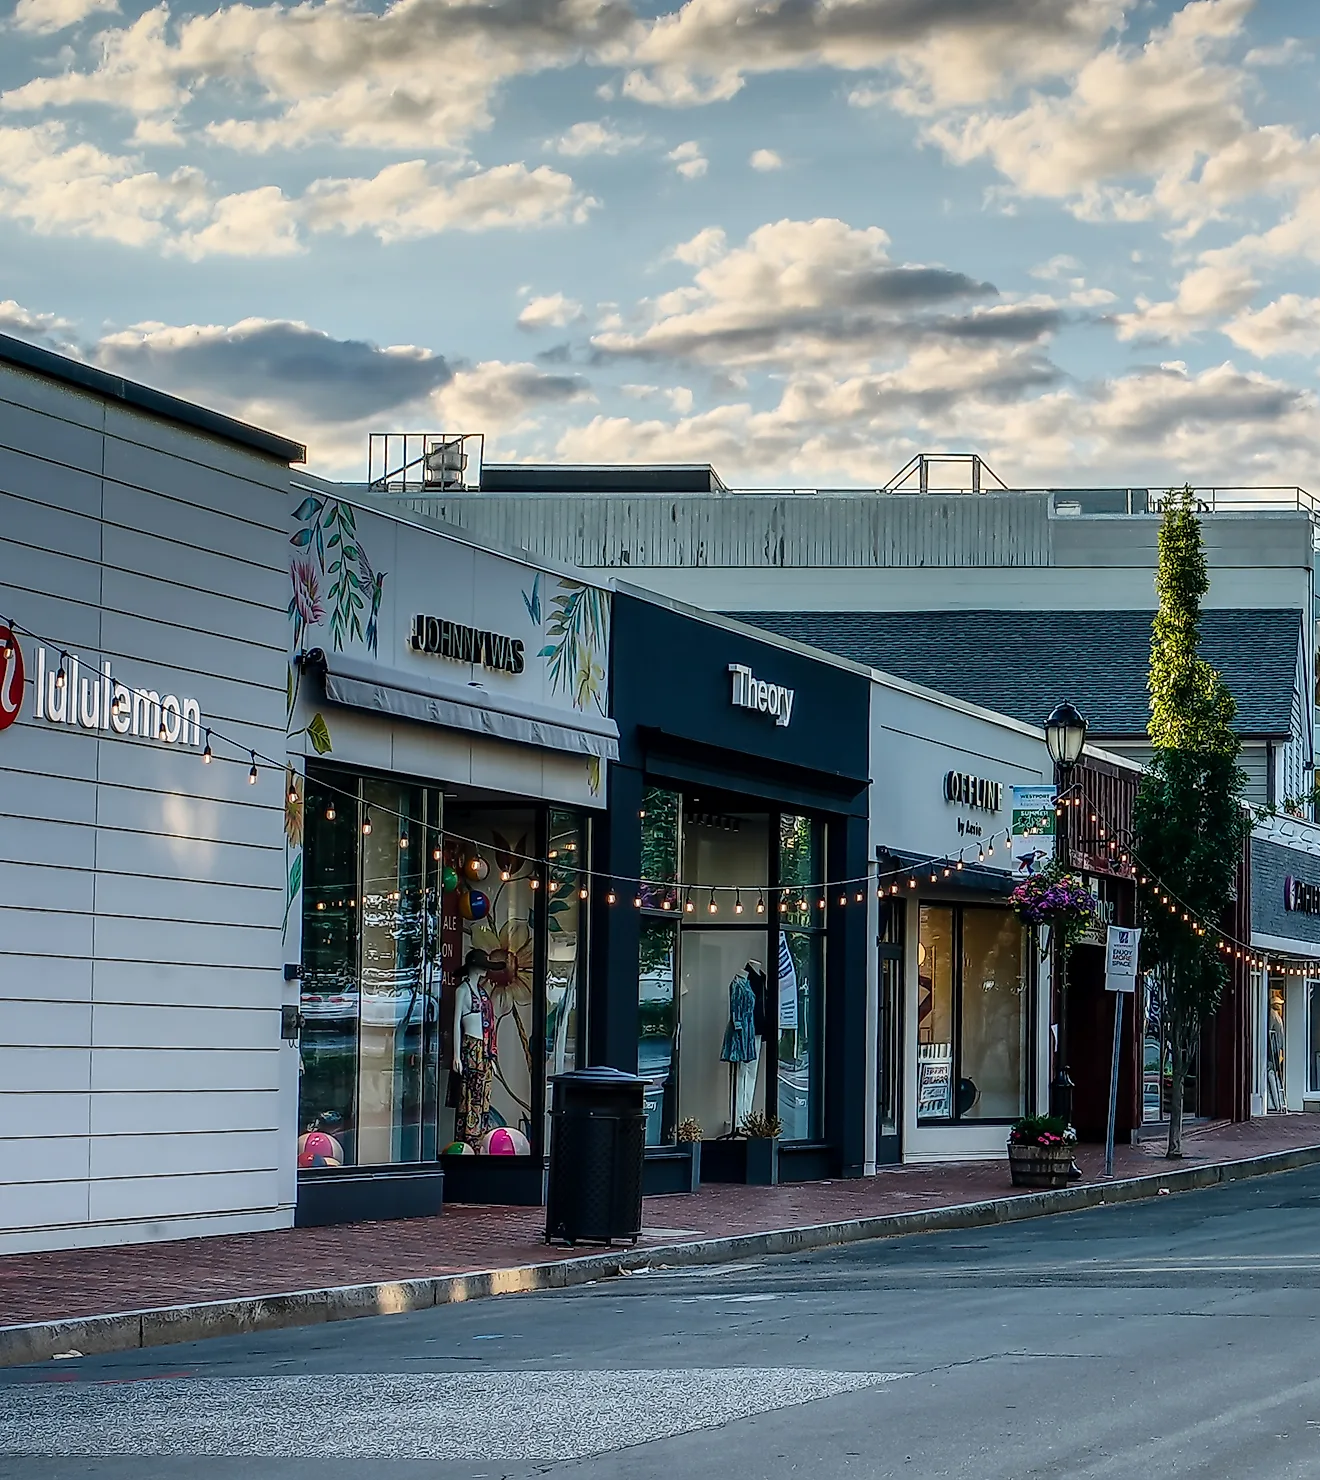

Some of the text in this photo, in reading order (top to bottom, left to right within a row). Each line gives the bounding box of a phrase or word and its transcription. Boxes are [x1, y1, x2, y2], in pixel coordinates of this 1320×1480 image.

[410, 614, 525, 674] JOHNNY WAS
[33, 647, 201, 746] lululemon
[728, 663, 794, 727] Theory
[943, 769, 1003, 812] OFFLINE
[443, 915, 457, 931] ALE
[441, 943, 453, 958] ON
[442, 971, 455, 986] ALE
